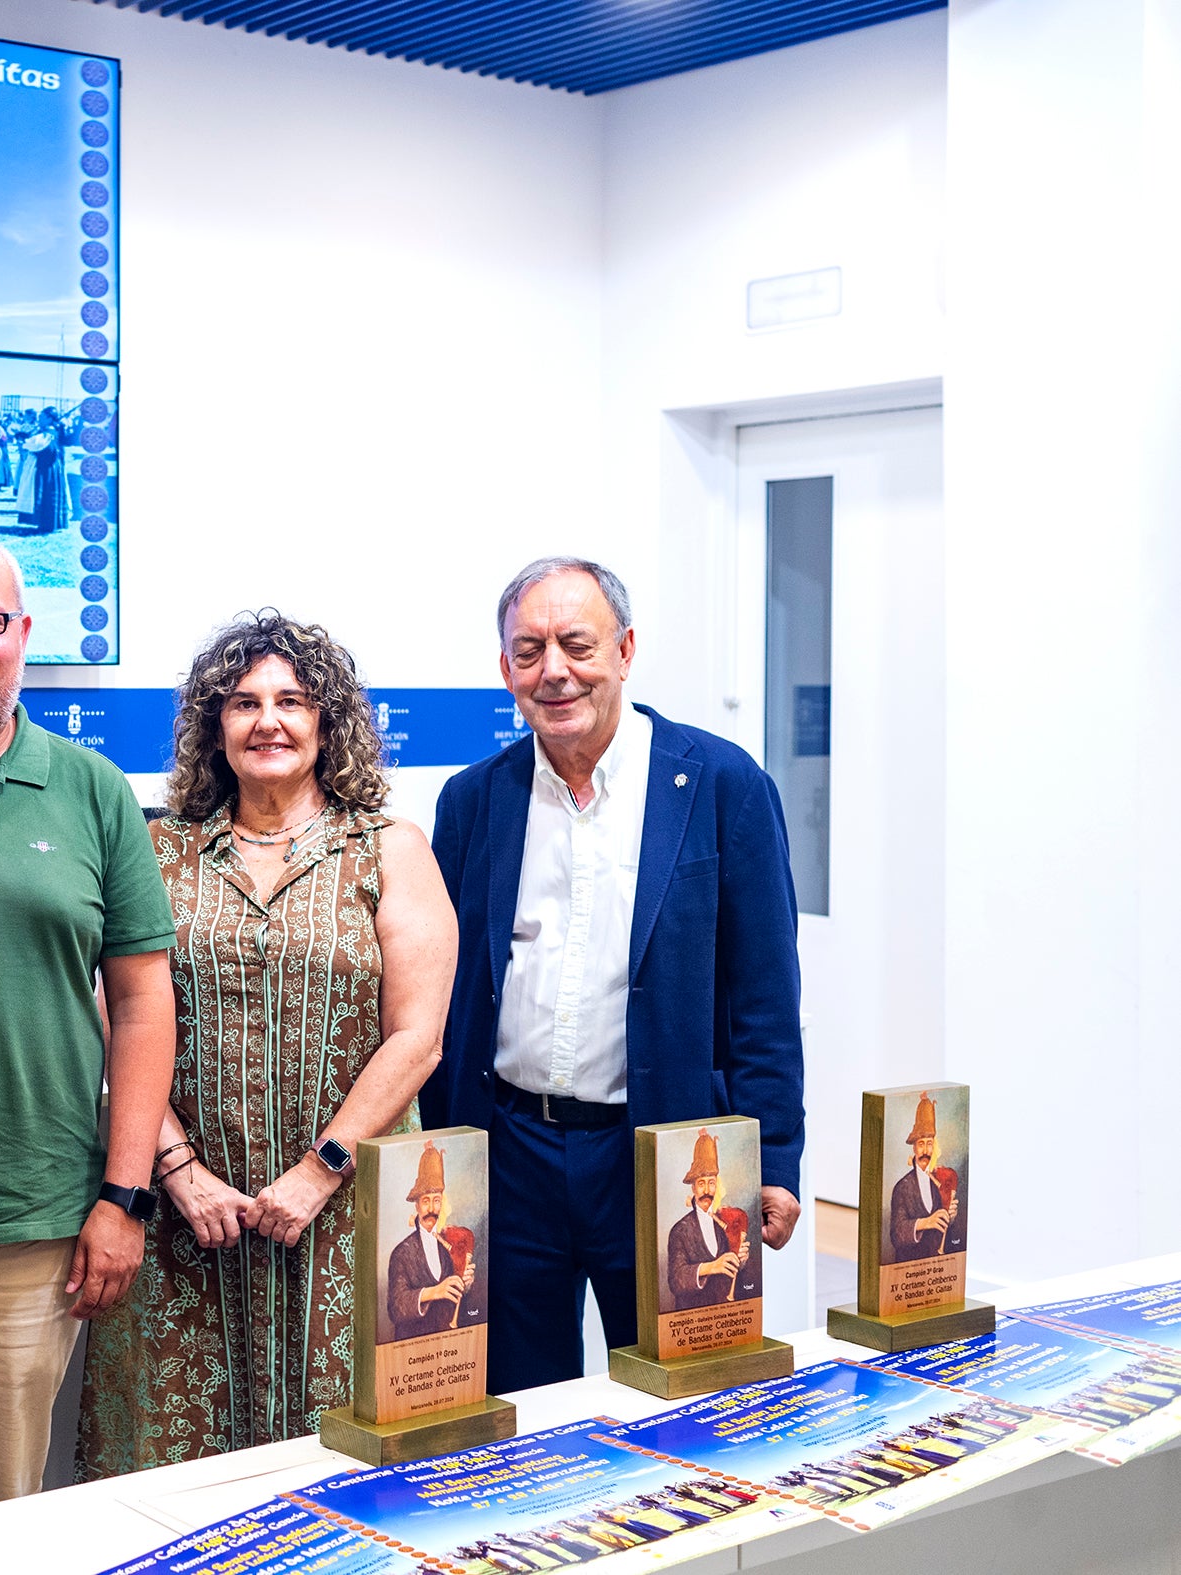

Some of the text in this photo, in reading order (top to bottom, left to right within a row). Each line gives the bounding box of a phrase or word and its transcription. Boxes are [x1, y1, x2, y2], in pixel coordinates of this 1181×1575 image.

[890, 1274, 958, 1293] XV Certame Celtibérico
[894, 1283, 953, 1302] de Bandas de Gaitas
[668, 1317, 694, 1328] Campión
[671, 1316, 753, 1338] XV Certame Celtibérico
[676, 1327, 748, 1347] de Bandas de Gaitas
[408, 1353, 435, 1365] Campión
[443, 1348, 459, 1358] Grao
[389, 1360, 476, 1387] XV Certame Celtibérico
[395, 1372, 470, 1397] de Bandas de Gaitas
[530, 1459, 611, 1483] Manzaneda
[302, 1485, 326, 1496] XV
[327, 1469, 395, 1489] Certame
[471, 1500, 492, 1509] 27
